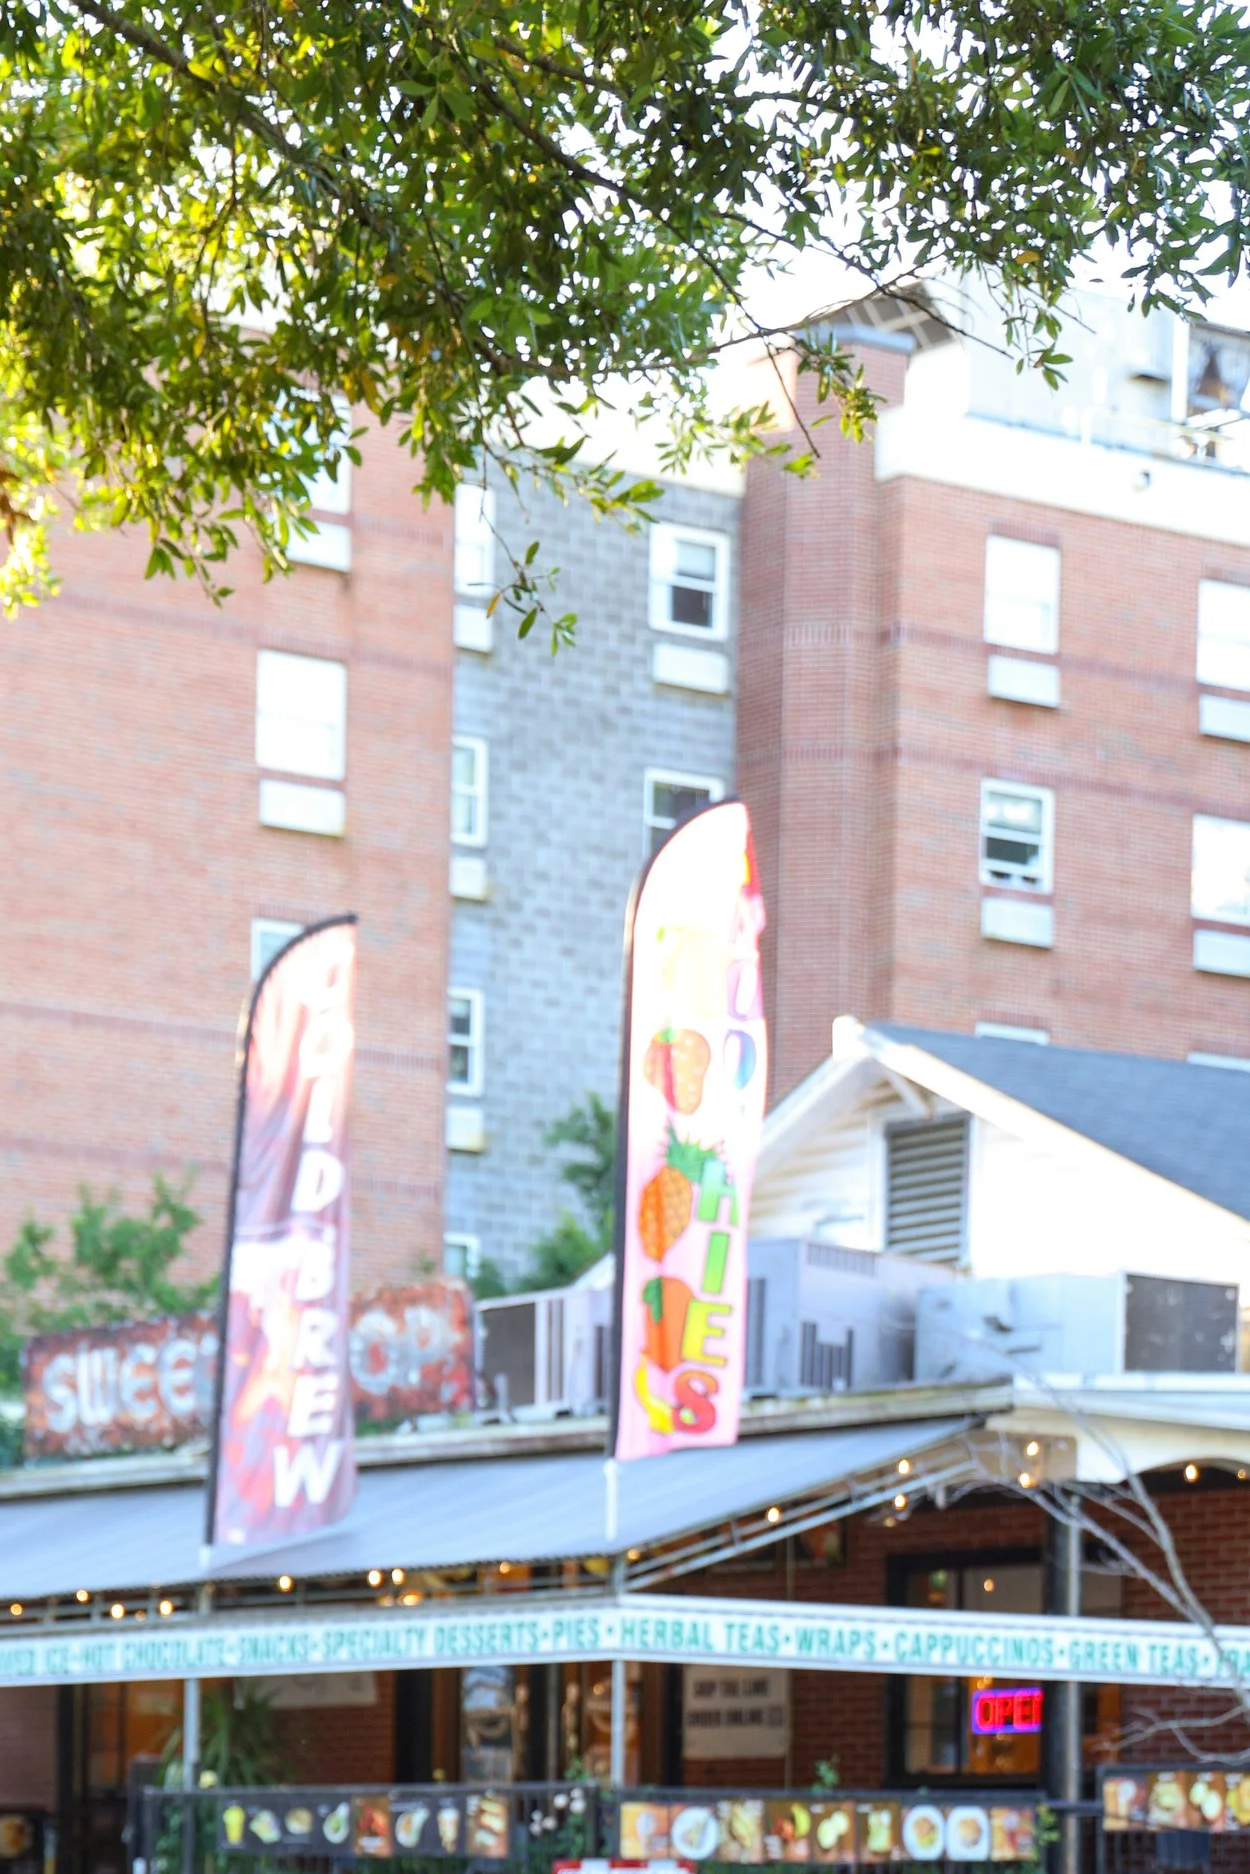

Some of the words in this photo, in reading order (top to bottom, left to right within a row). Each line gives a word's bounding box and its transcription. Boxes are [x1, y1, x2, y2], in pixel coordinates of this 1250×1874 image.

[273, 1222, 342, 1508] BREW
[350, 1306, 452, 1396] OP
[124, 1634, 226, 1671] CHOCOLATE
[239, 1631, 309, 1665] SNACKS
[323, 1624, 427, 1660] SPECIALTY
[435, 1619, 539, 1657] DESSERTS
[554, 1616, 600, 1651] PIES
[620, 1616, 713, 1651] HERBAL
[725, 1622, 781, 1655] TEAS
[796, 1625, 877, 1659] WRAPS
[895, 1628, 1053, 1668] CAPPUCCINOS
[1069, 1639, 1138, 1671] GREEN
[1149, 1643, 1199, 1676] TEAS
